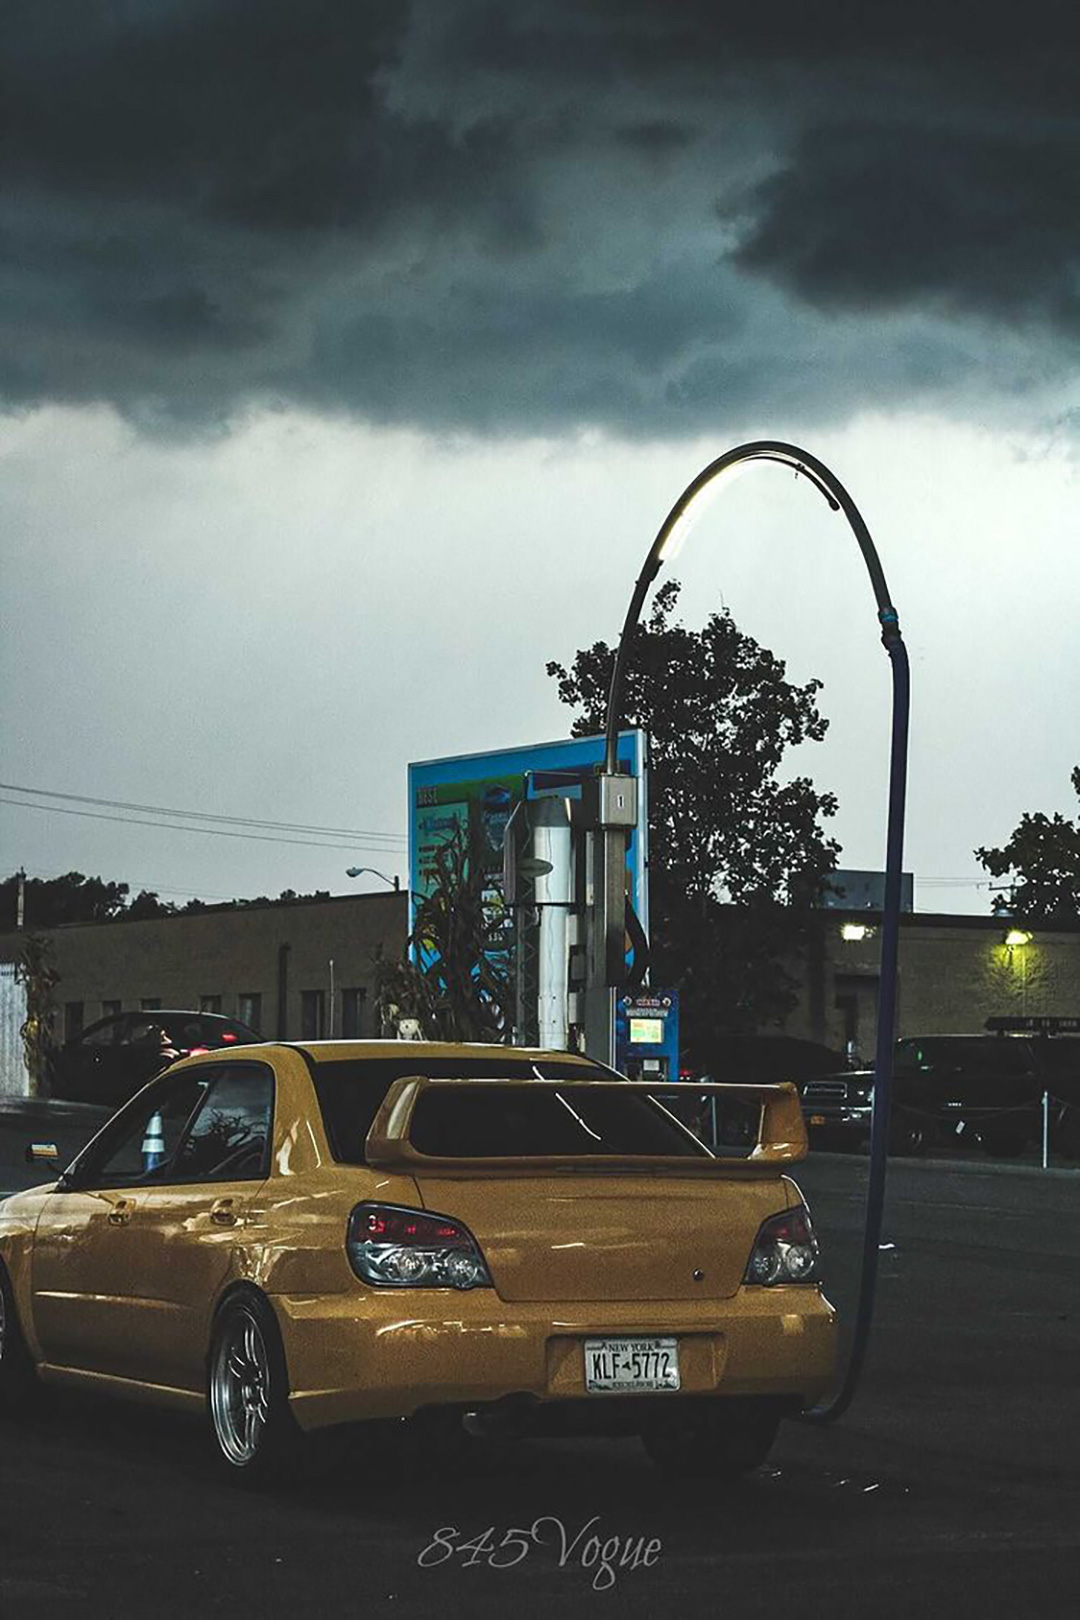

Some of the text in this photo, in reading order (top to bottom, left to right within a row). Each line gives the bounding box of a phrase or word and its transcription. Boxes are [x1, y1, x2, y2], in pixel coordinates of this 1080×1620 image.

[608, 1342, 655, 1353] NEW YORK
[593, 1352, 671, 1380] KLF 5772
